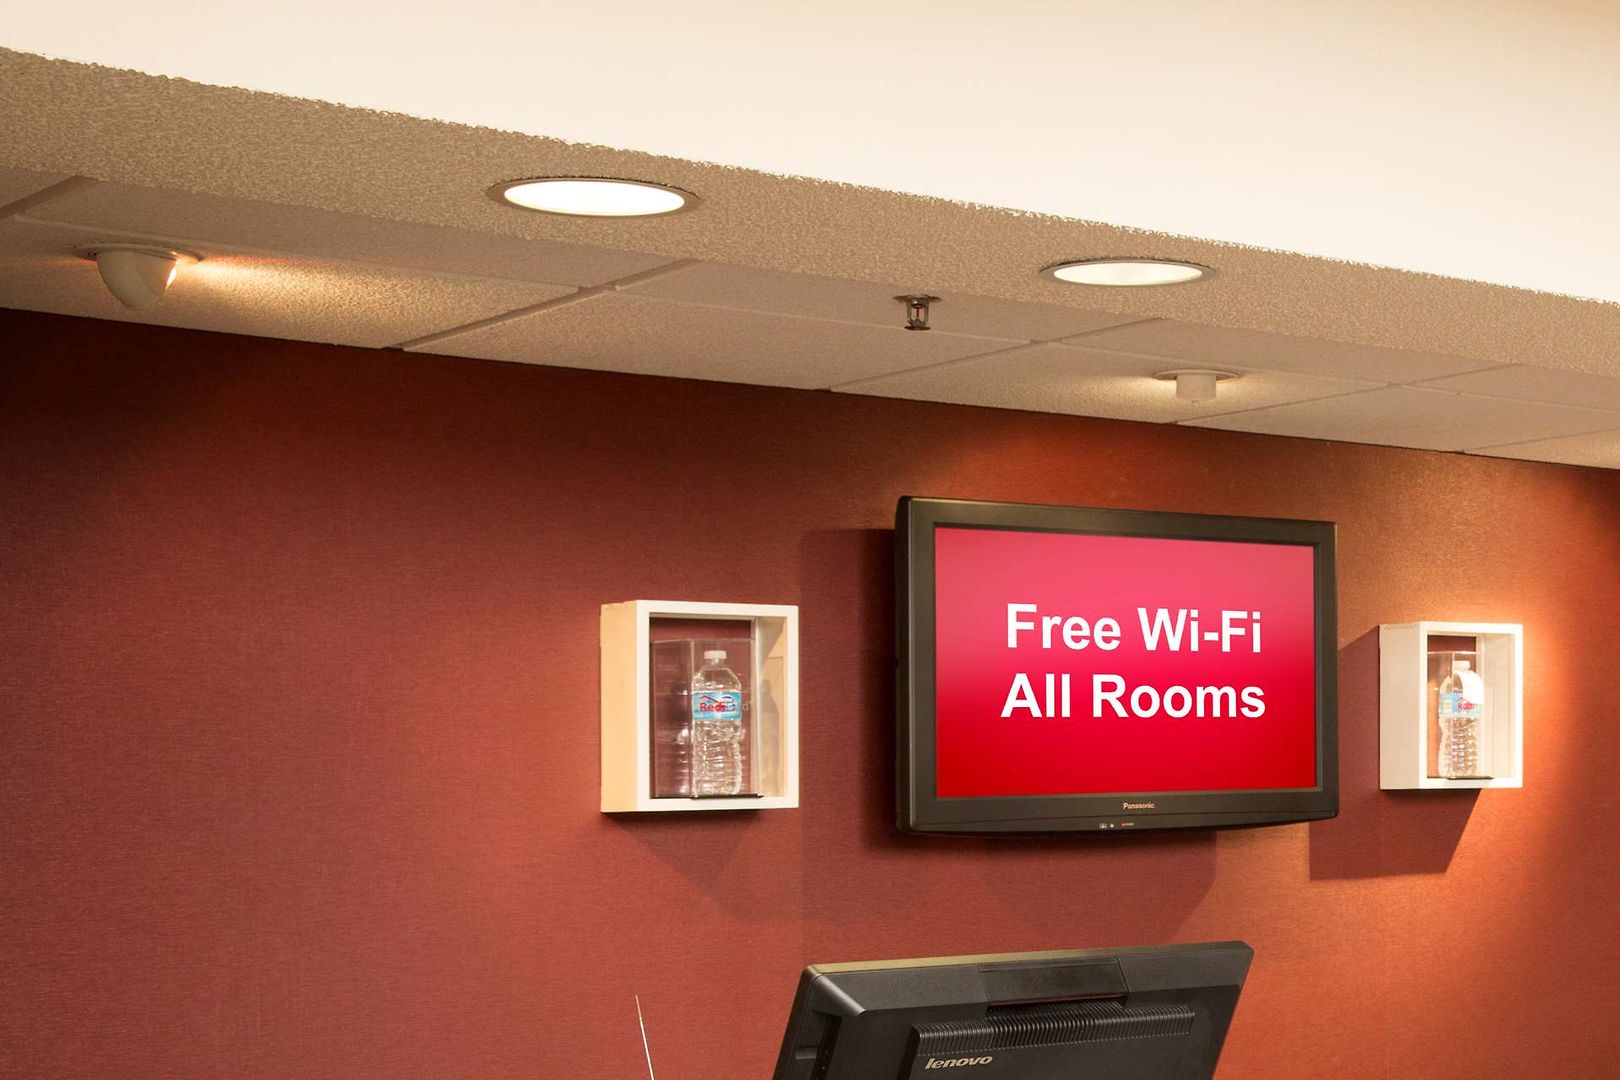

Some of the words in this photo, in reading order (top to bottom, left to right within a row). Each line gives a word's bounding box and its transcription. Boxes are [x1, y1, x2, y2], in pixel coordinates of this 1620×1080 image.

[1006, 602, 1121, 651] Free
[1137, 607, 1263, 653] Wi-Fi
[1000, 672, 1072, 718] All
[1092, 673, 1266, 719] Rooms
[925, 1056, 993, 1070] lenovo
